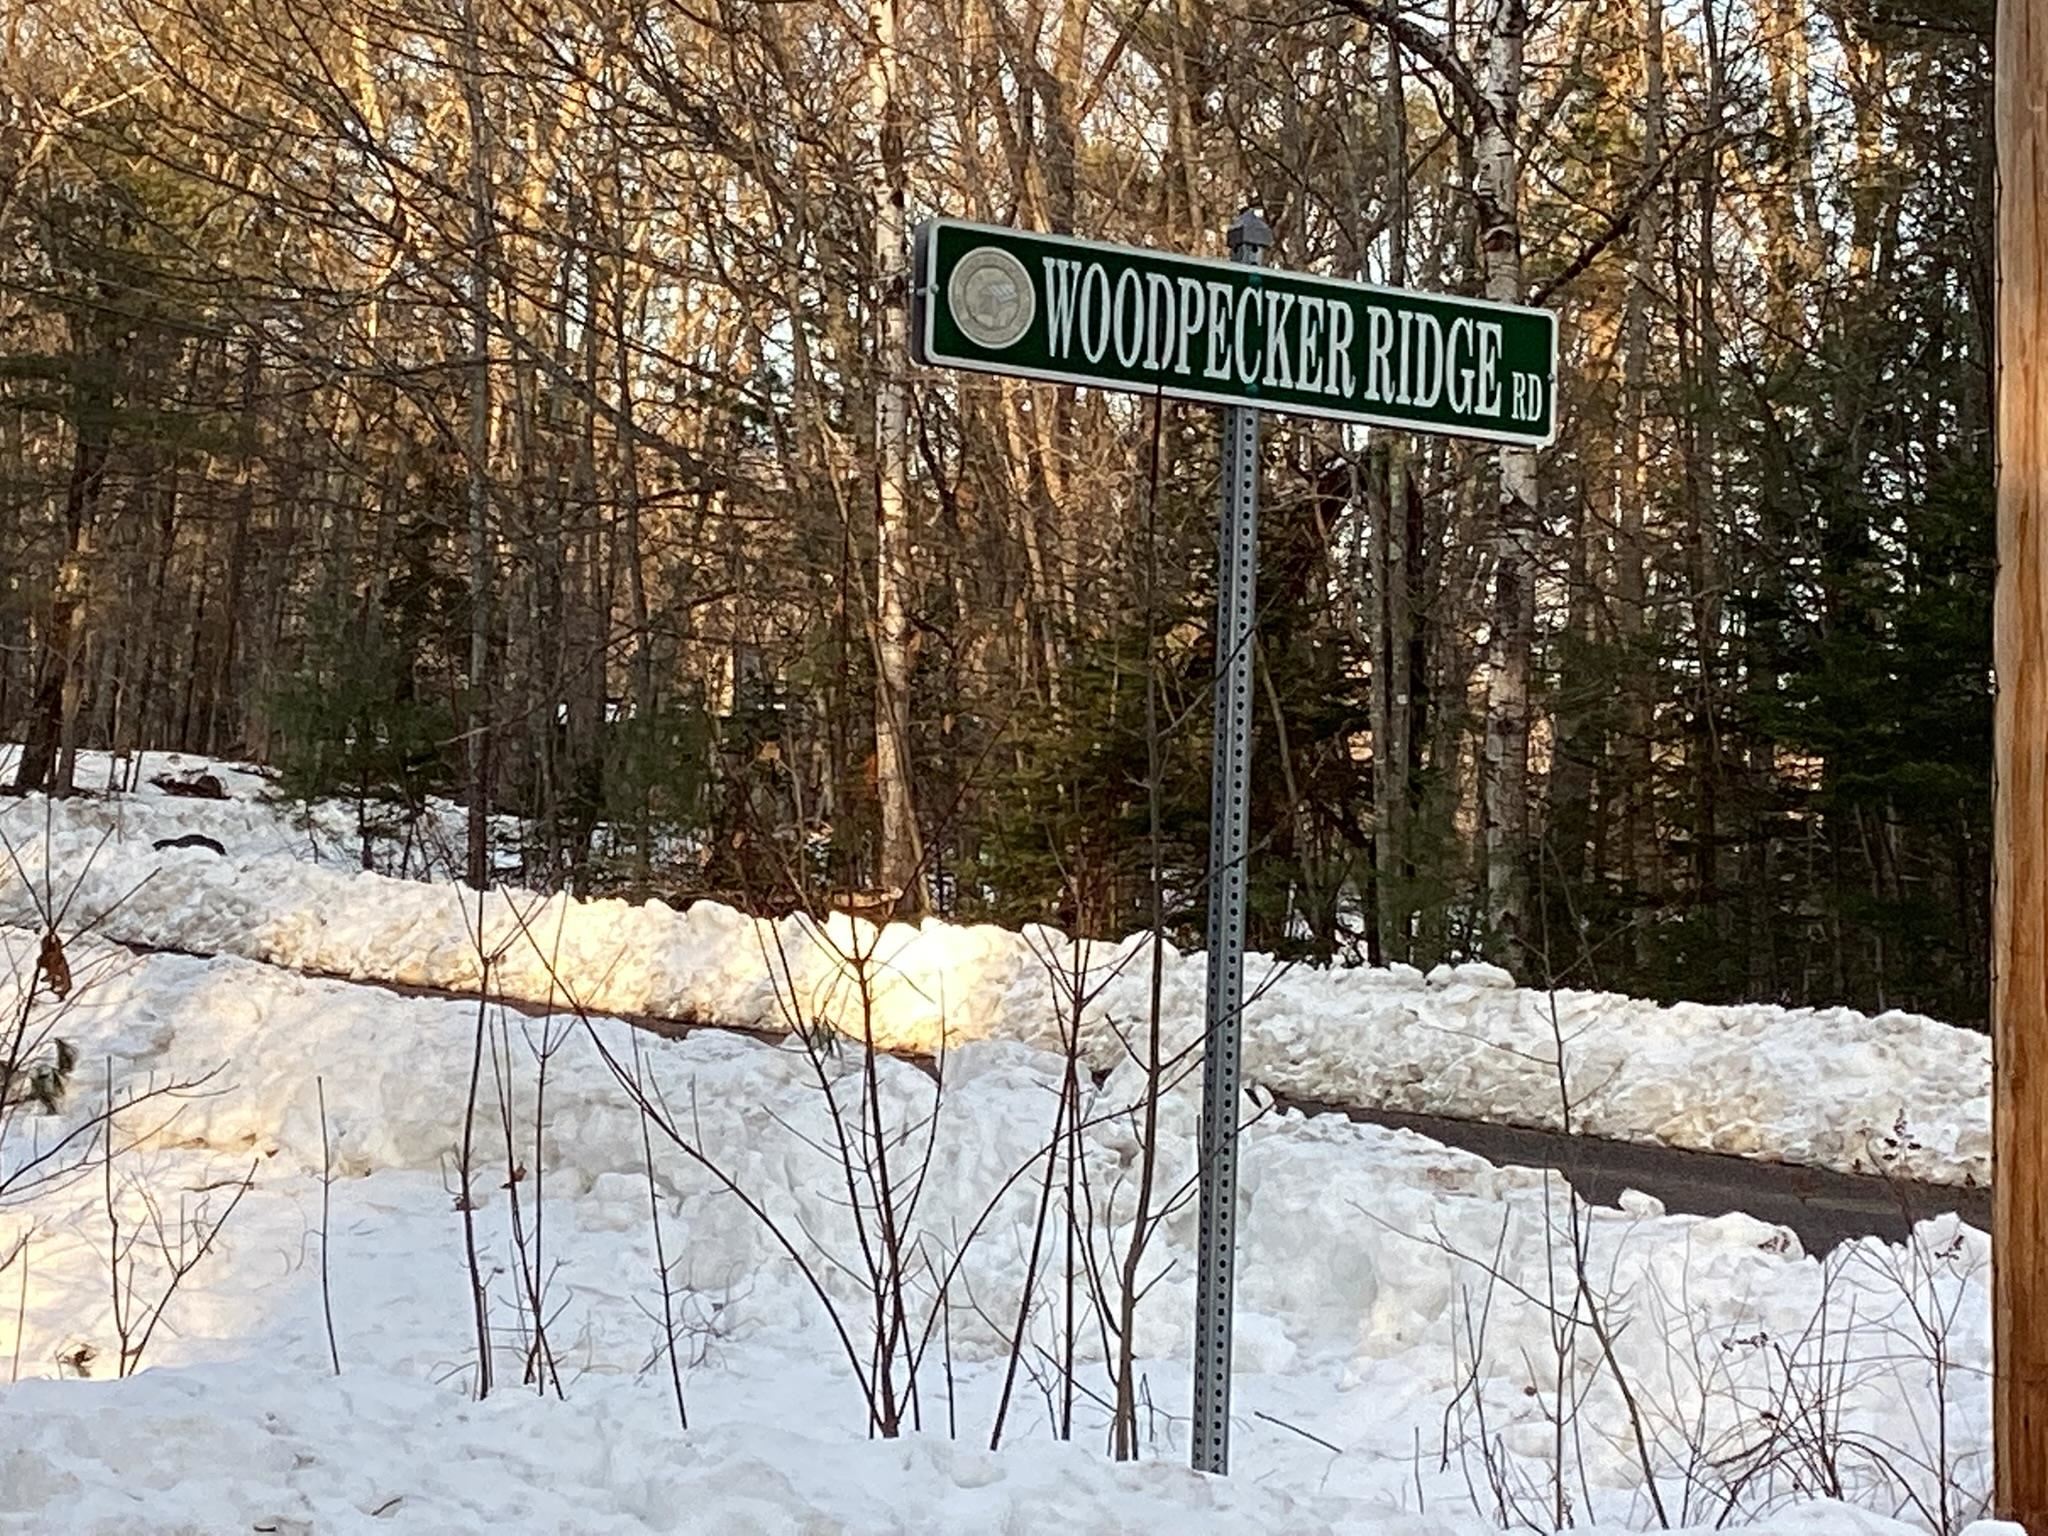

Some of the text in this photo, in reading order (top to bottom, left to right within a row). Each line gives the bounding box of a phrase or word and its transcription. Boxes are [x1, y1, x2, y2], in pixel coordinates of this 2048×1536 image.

[1043, 257, 1356, 399] WOODPECKER
[1365, 306, 1503, 417] RIDGE
[1511, 372, 1542, 421] RD
